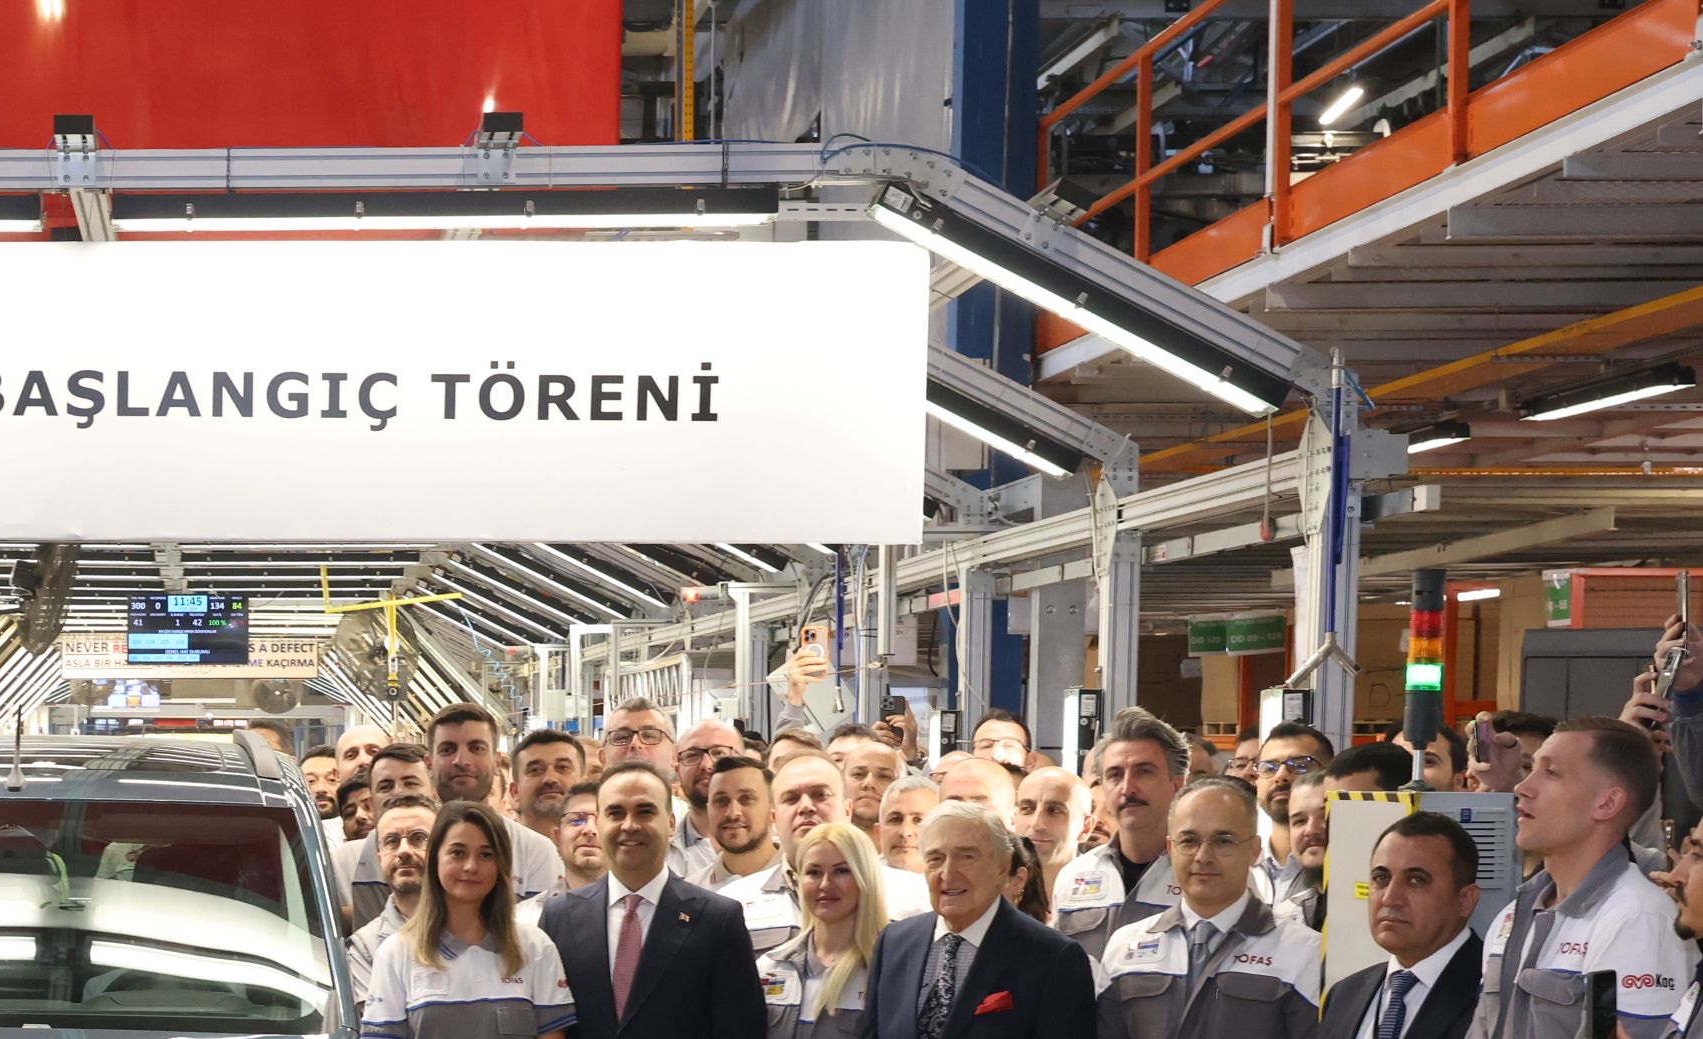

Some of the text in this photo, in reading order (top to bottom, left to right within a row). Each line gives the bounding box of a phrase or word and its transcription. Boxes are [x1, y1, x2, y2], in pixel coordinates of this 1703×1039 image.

[431, 361, 720, 422] TÖRENİ
[131, 602, 146, 610] 300
[155, 602, 161, 610] 0
[173, 597, 203, 606] 11:45
[210, 602, 225, 610] 134
[232, 602, 243, 610] 84
[133, 619, 143, 627] 41
[192, 619, 203, 627] 42
[65, 642, 109, 653] NEVER
[258, 643, 267, 653] A
[271, 643, 315, 653] DEFECT
[65, 659, 91, 668] ASLA
[94, 658, 113, 668] BİR
[266, 658, 315, 669] KAÇIRMA
[1655, 973, 1675, 991] Koç
